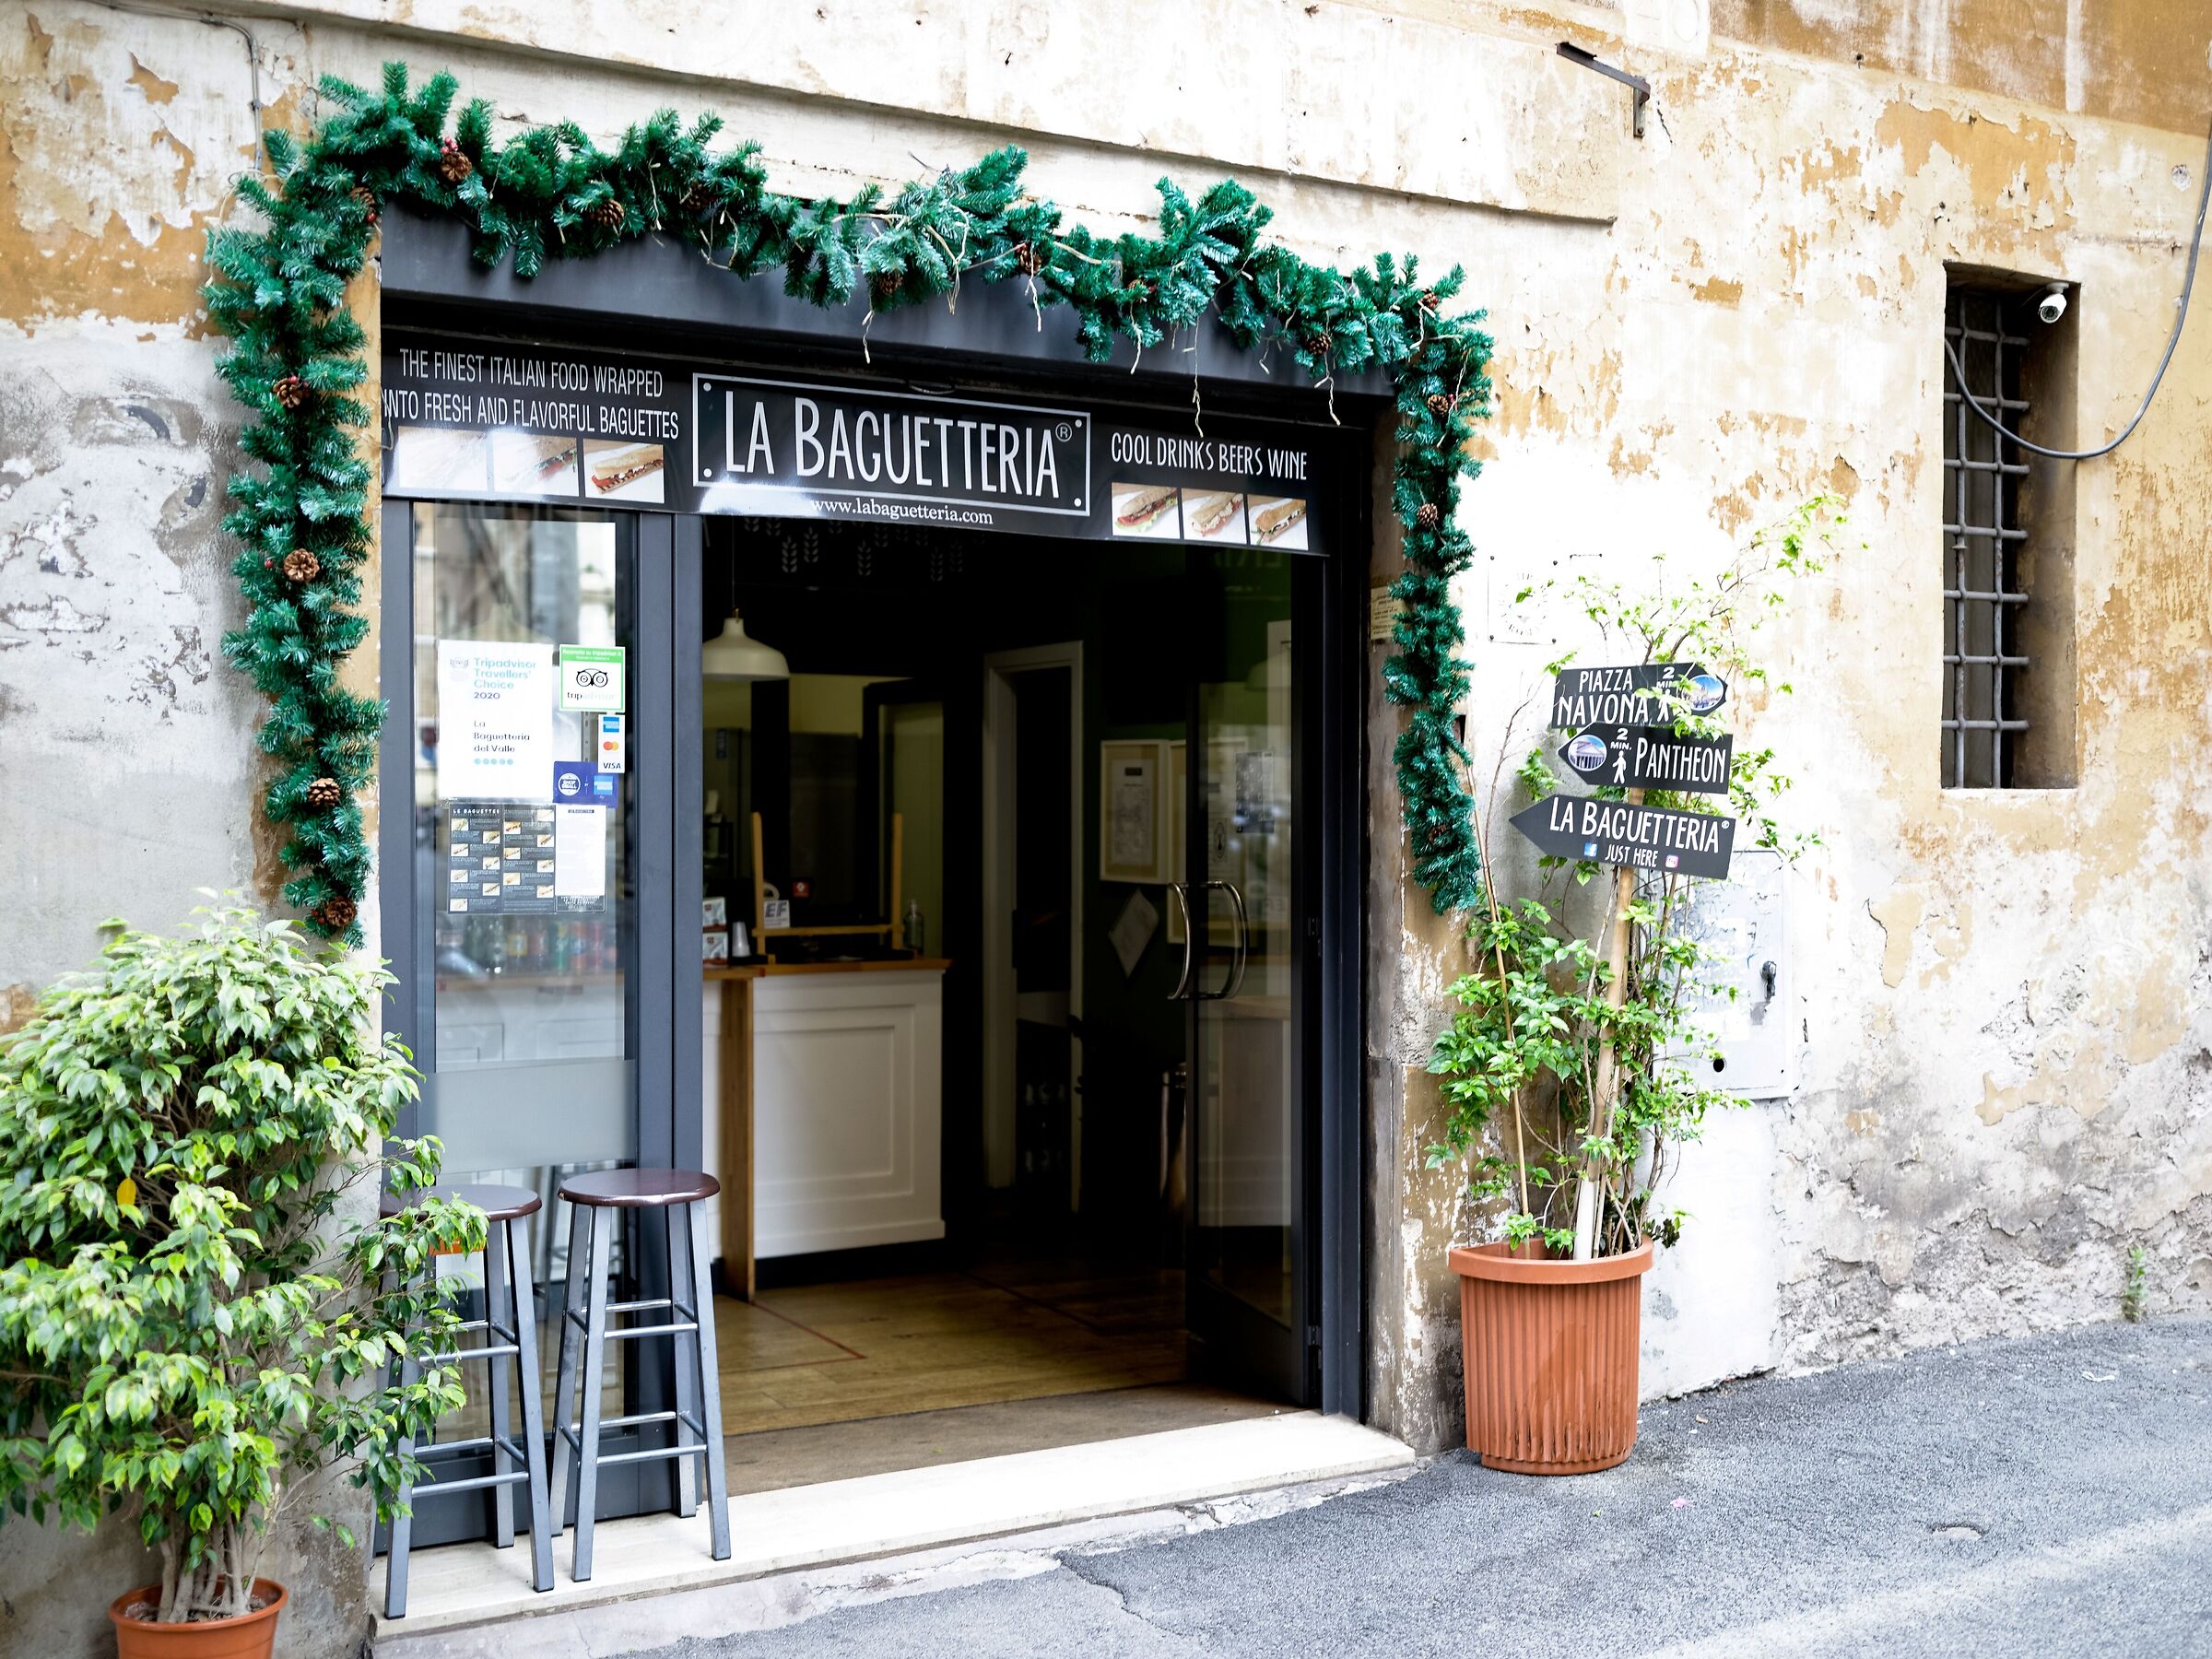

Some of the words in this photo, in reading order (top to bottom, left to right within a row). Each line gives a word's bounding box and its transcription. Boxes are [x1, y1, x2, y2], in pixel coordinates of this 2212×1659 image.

[400, 348, 429, 378] THE
[434, 351, 484, 382] FINEST
[489, 356, 546, 388] ITALIAN
[551, 362, 588, 392] FOOD
[594, 365, 663, 398] WRAPPED
[383, 388, 419, 419] INTO
[425, 392, 472, 423] FRESH
[477, 396, 508, 425] AND
[513, 399, 595, 432] FLAVORFUL
[600, 406, 679, 439] BAGUETTES
[725, 391, 774, 475] LA
[1112, 432, 1153, 465] COOL
[1157, 437, 1213, 471] DRINKS
[1218, 443, 1264, 476] BEERS
[1267, 449, 1308, 480] WINE
[810, 498, 994, 525] www.labaguetteria.com
[474, 657, 536, 669] Tripadvisor
[1662, 666, 1675, 679] 2
[474, 679, 514, 689] Choice
[1579, 668, 1633, 693] PIAZZA
[474, 691, 500, 700] 2020
[1557, 693, 1649, 725] NAVONA
[1617, 727, 1629, 741] 2
[1634, 737, 1726, 783] PANTHEON
[1550, 797, 1574, 833] LA
[1605, 844, 1630, 864] JUST
[1632, 847, 1659, 868] HERE
